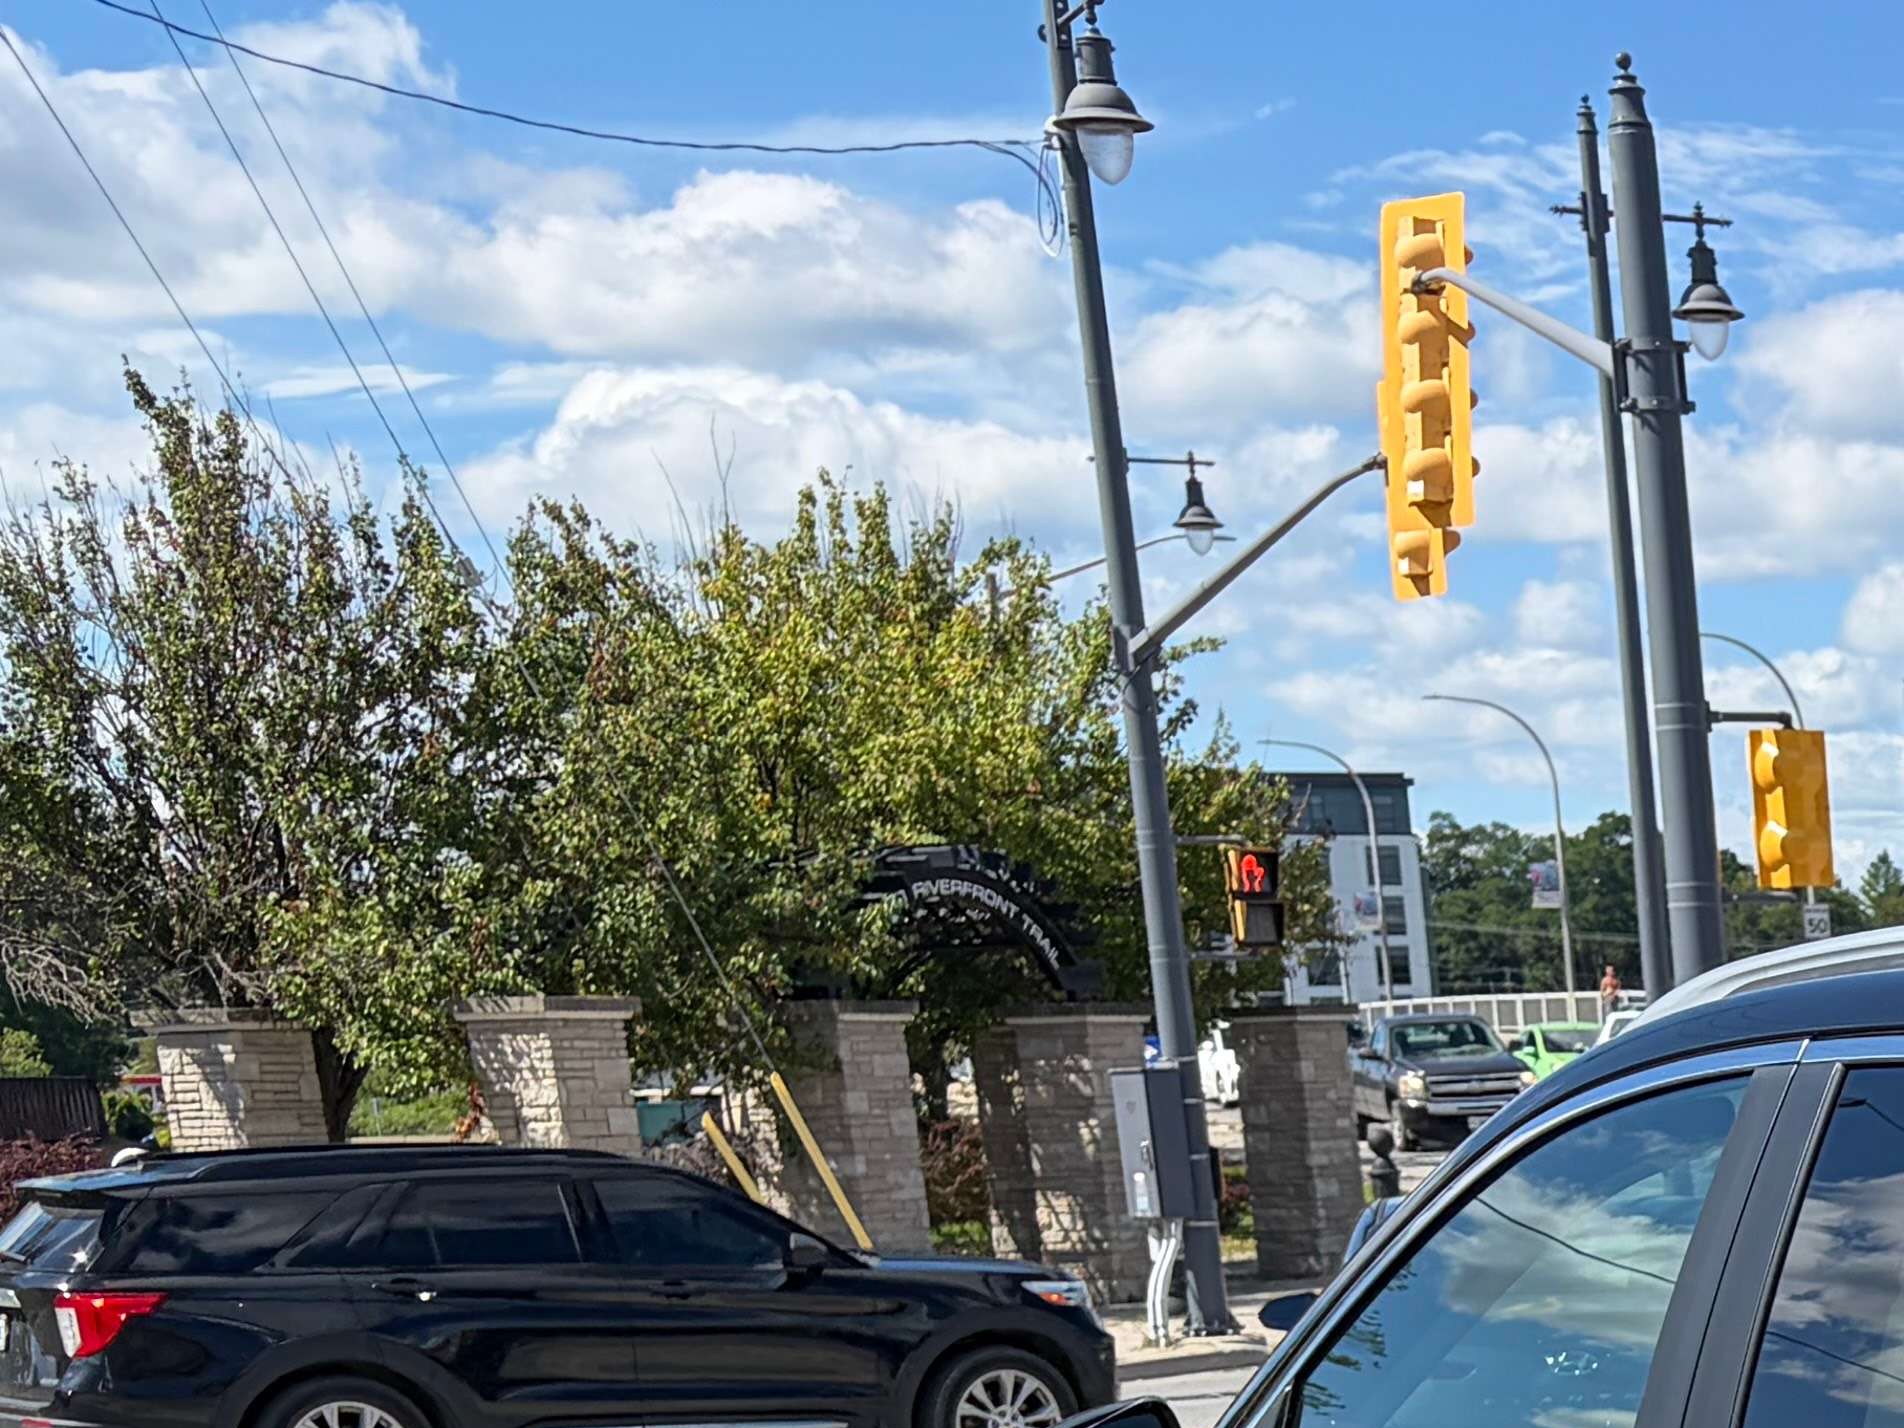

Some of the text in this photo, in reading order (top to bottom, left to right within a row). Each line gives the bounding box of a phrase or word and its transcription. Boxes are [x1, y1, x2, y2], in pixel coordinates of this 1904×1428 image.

[911, 877, 1021, 920] RIVERFRONT
[1021, 912, 1061, 972] TRAIL
[1808, 917, 1828, 934] 50
